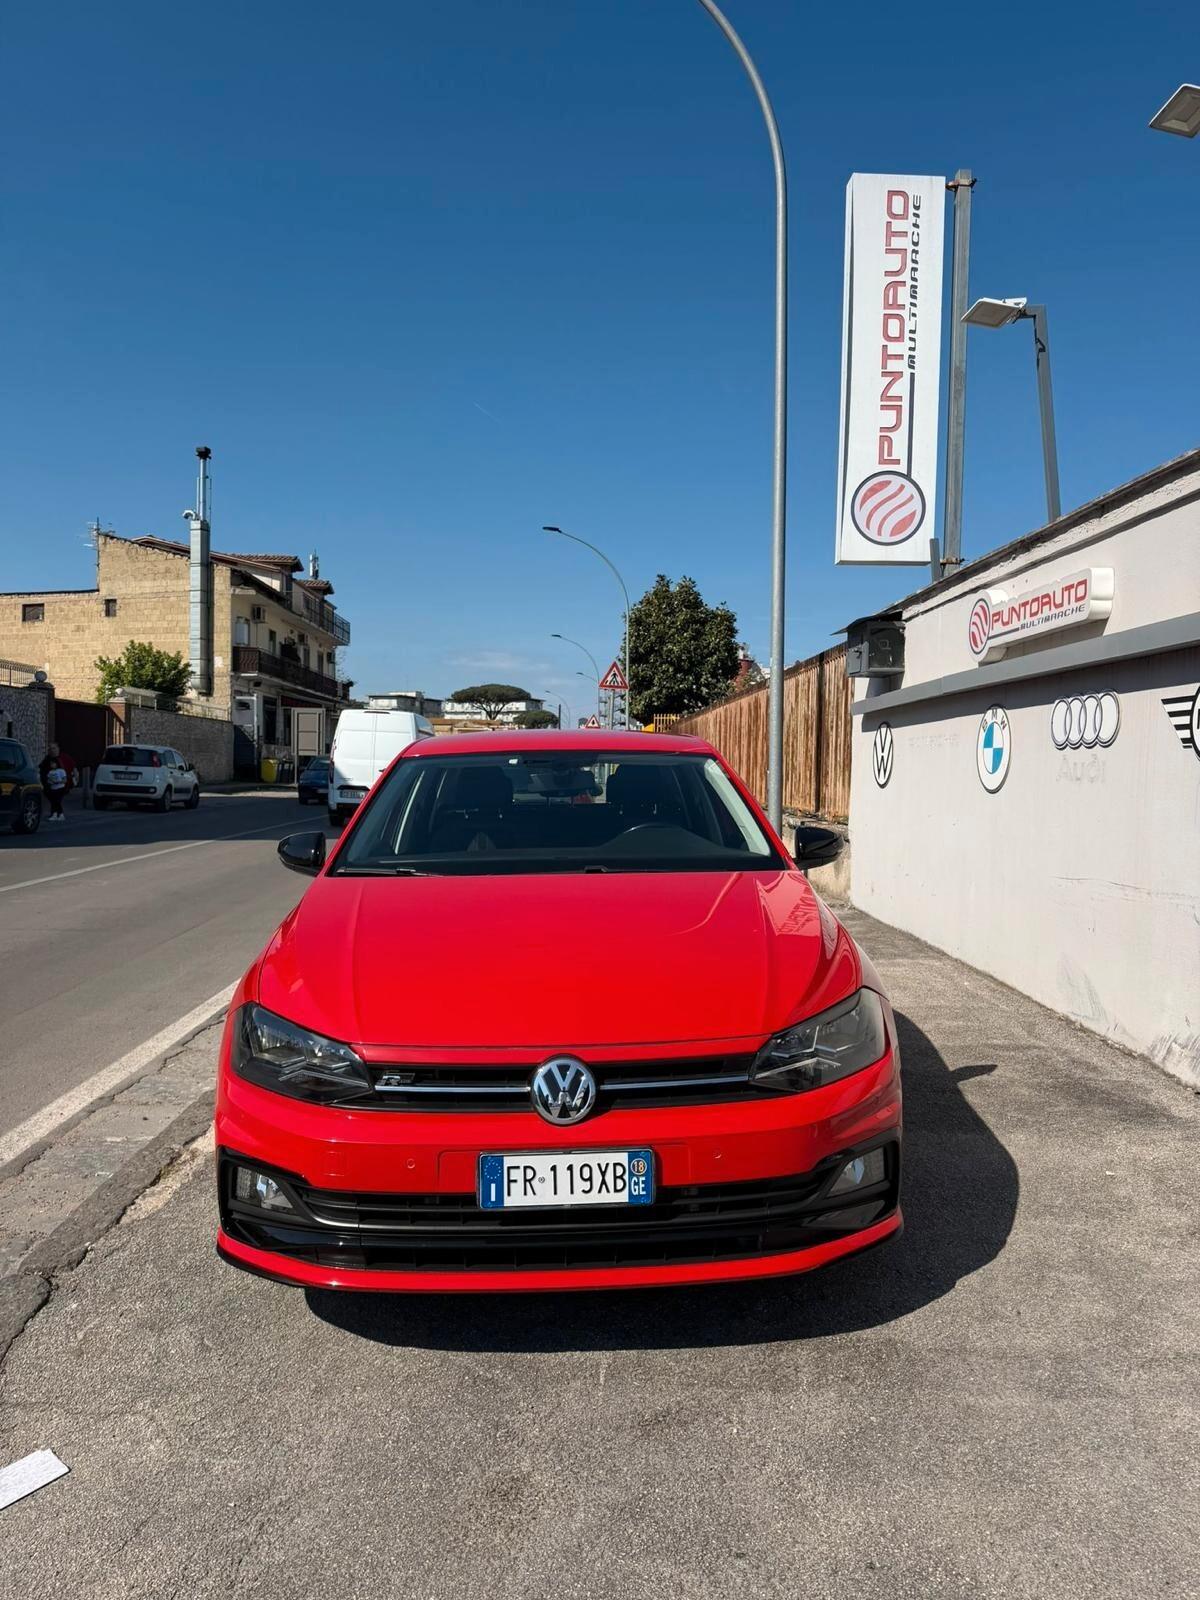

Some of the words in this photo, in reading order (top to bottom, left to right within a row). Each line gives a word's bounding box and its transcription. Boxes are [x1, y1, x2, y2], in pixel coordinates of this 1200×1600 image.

[907, 193, 922, 370] MULTIMARCHE
[878, 189, 910, 465] PUNTOAUTO
[991, 578, 1088, 631] PUNTOAUTO
[1020, 603, 1086, 631] MULTIMARCHE
[630, 1176, 647, 1196] GE
[632, 1160, 645, 1173] 18
